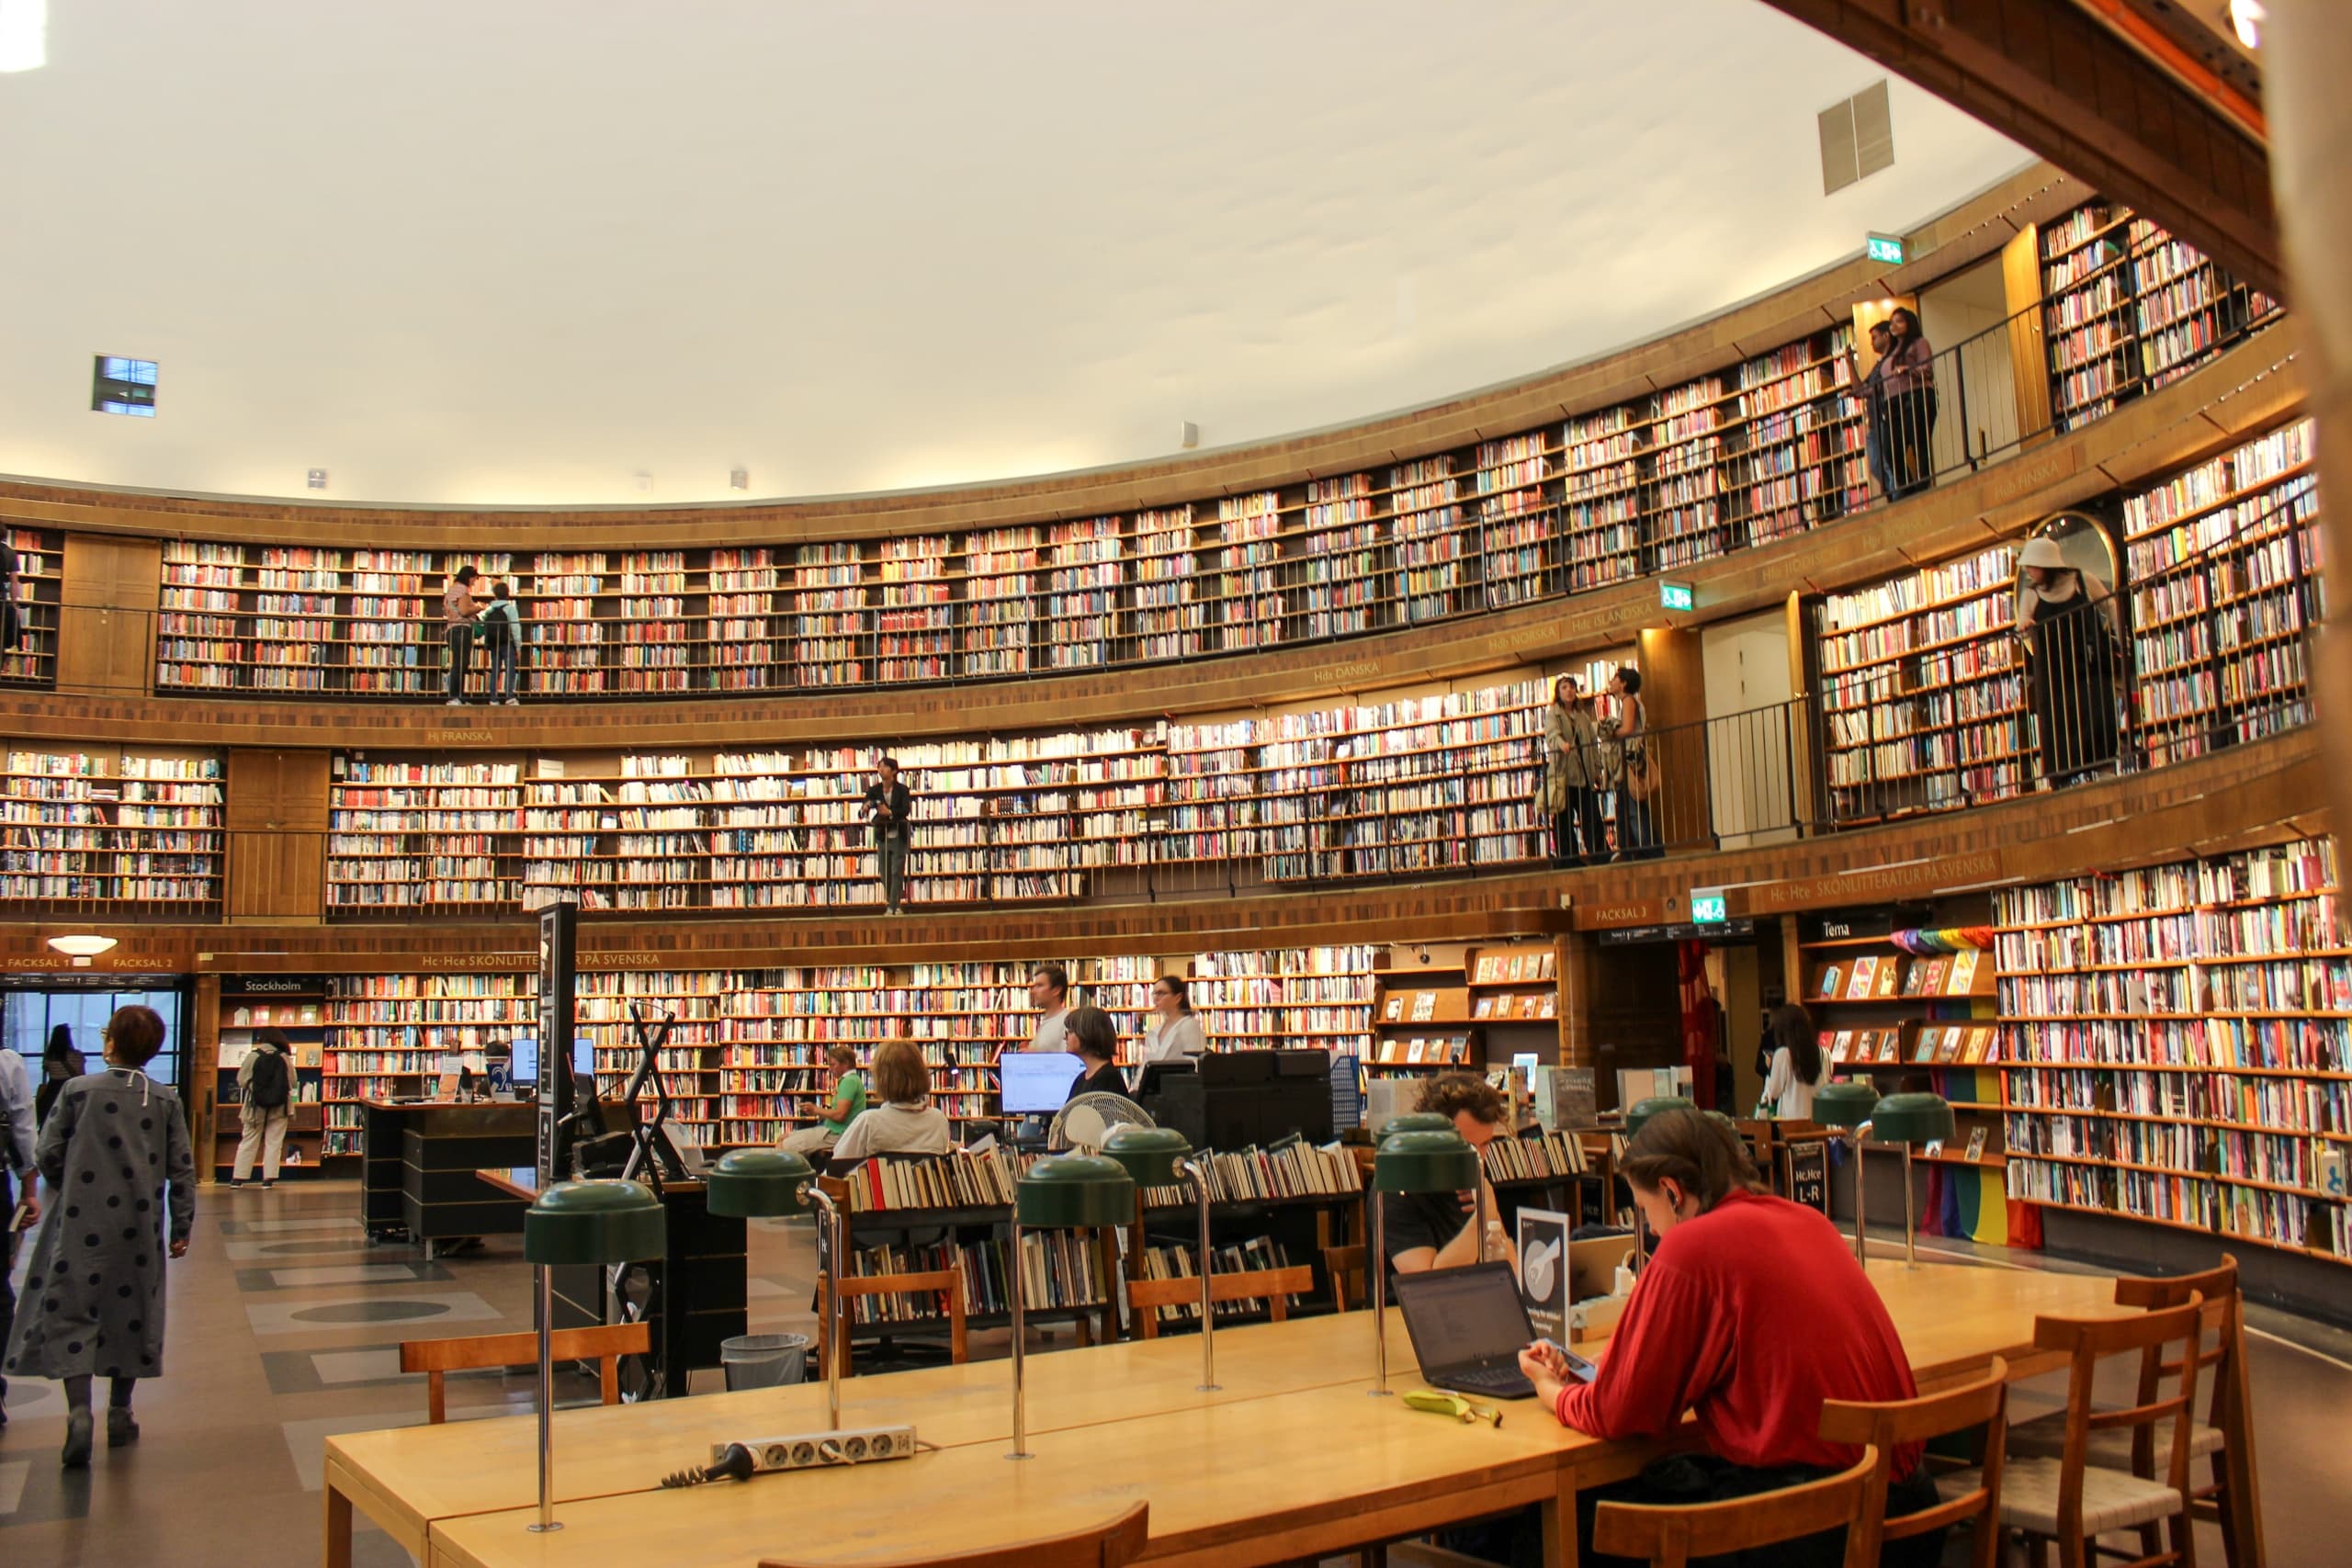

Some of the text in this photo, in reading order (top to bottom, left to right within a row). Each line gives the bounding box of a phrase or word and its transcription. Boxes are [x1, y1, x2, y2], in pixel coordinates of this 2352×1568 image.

[1511, 626, 1556, 646] NORSKA
[1336, 661, 1379, 678] DANSKA
[442, 731, 493, 741] FRANSKA
[1596, 907, 1638, 921] FACKSAL
[1823, 921, 1850, 937] Tema
[7, 958, 59, 967] FACKSAL
[113, 959, 173, 967] FACKSAL 2
[604, 954, 660, 964] SVENSKA
[244, 980, 301, 991] Stockholm
